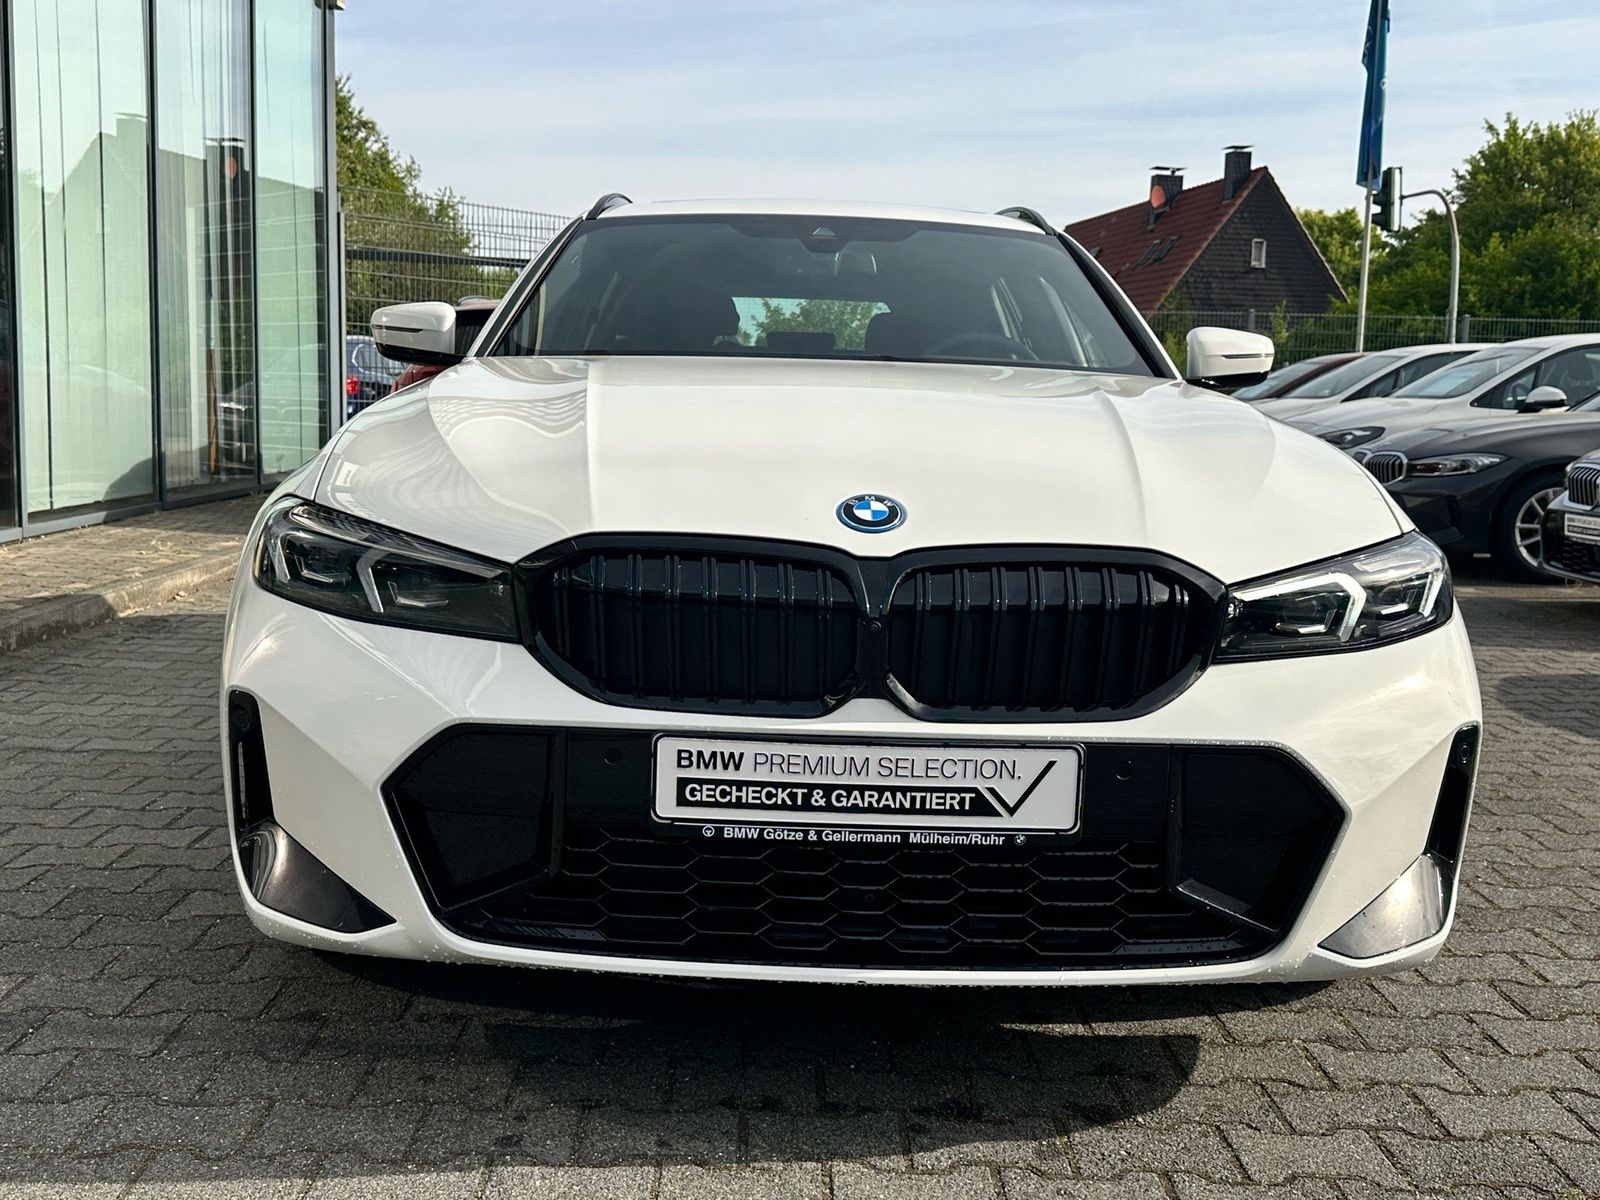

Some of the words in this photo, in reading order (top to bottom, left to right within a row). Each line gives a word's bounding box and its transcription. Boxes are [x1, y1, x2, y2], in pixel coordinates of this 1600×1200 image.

[676, 748, 745, 771] BMW
[753, 752, 870, 777] PREMIUM
[877, 756, 1022, 780] SELECTION.
[684, 783, 808, 806] GECHECKT
[810, 788, 827, 807] &
[830, 789, 976, 811] GARANTIERT
[723, 826, 760, 839] BMW
[763, 828, 804, 841] Götze
[807, 830, 818, 842] &
[821, 830, 901, 844] Gellermann
[908, 832, 1006, 846] Mülheim/Ruhr
